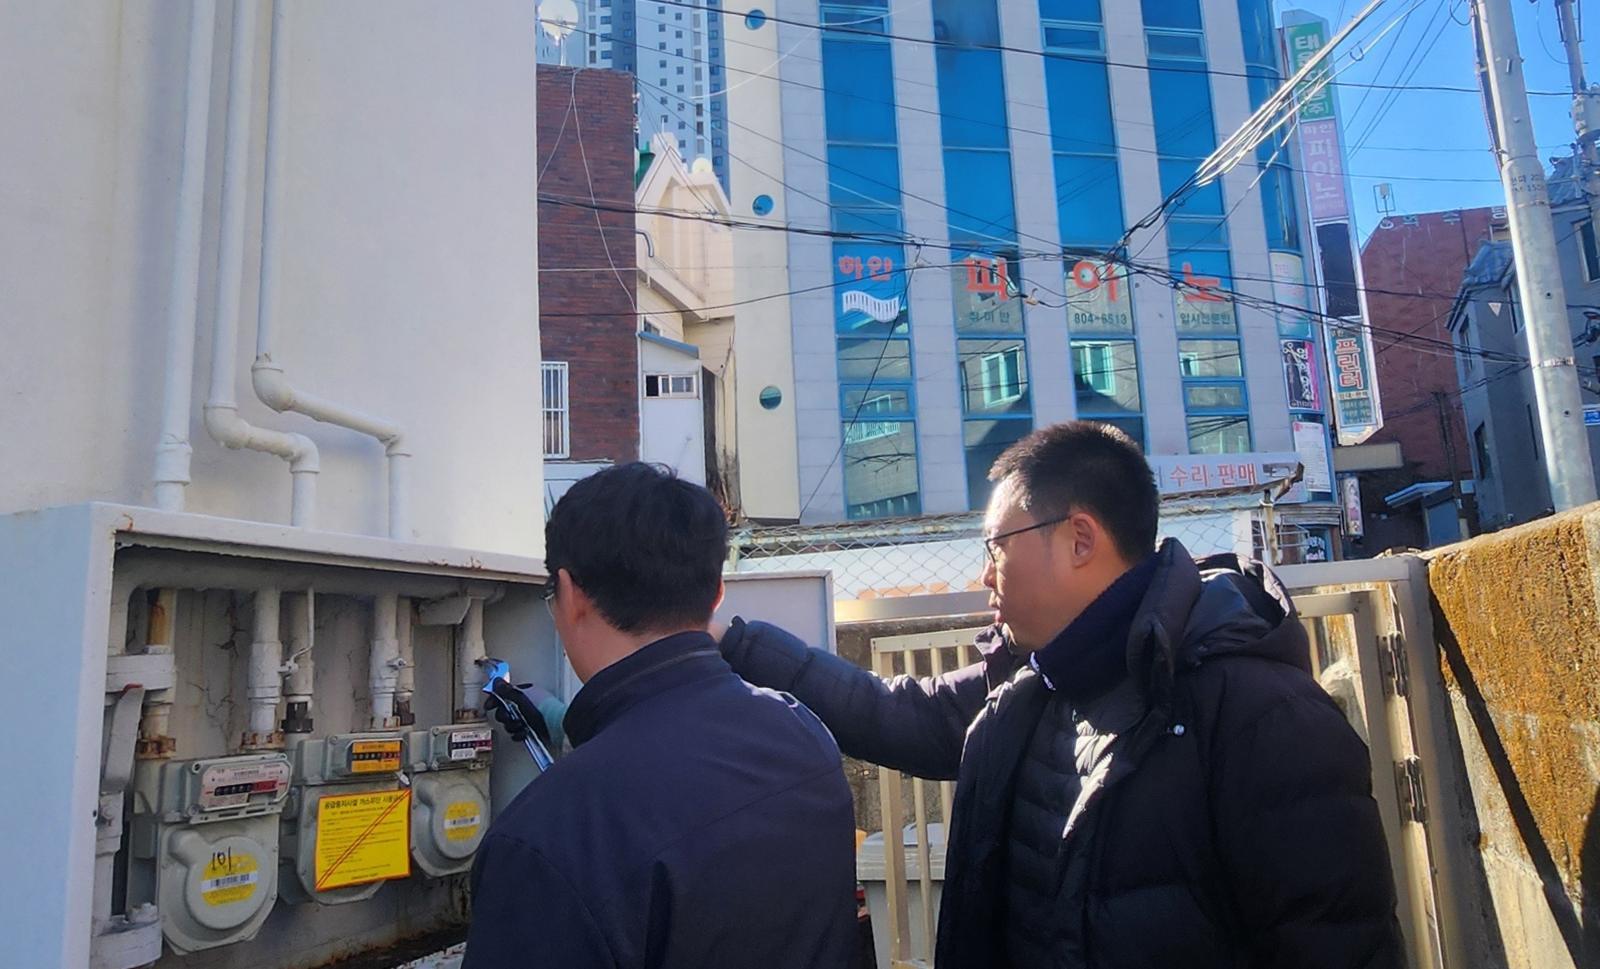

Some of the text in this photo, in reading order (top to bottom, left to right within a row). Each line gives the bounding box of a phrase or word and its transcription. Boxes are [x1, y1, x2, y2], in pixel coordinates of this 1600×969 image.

[1309, 138, 1340, 200] 피아노
[1074, 312, 1128, 325] 804-6513
[1335, 338, 1362, 389] 프린터
